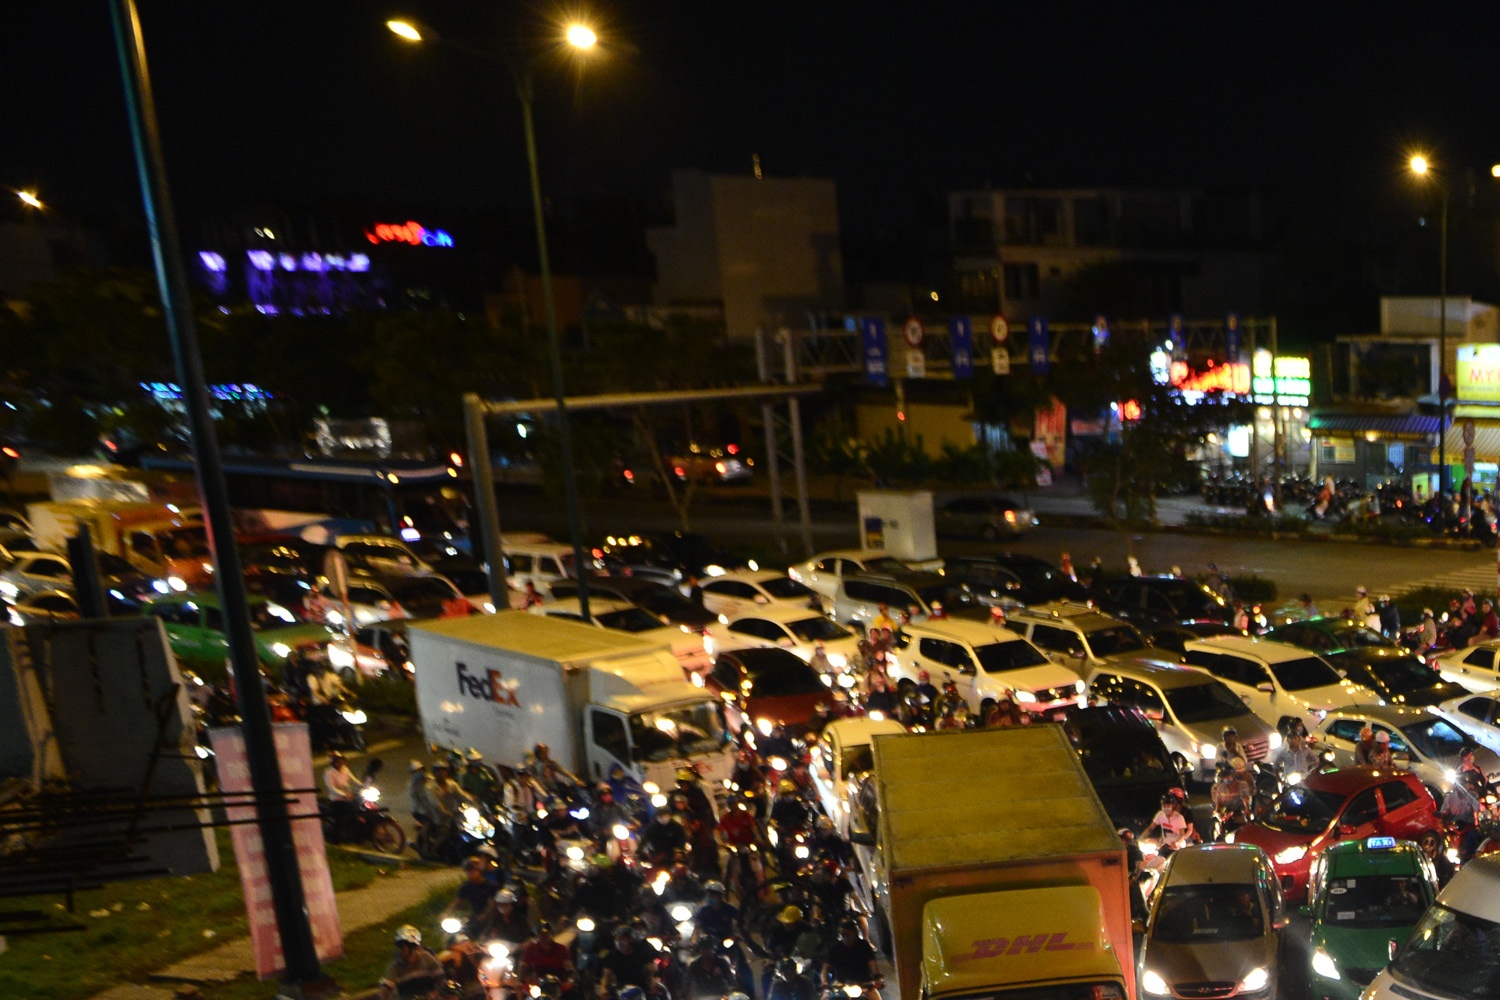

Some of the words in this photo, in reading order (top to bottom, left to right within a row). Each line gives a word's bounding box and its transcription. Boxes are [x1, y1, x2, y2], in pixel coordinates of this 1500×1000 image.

[455, 661, 521, 708] FedEx
[1370, 839, 1392, 848] TAXI
[970, 931, 1076, 961] DHL
